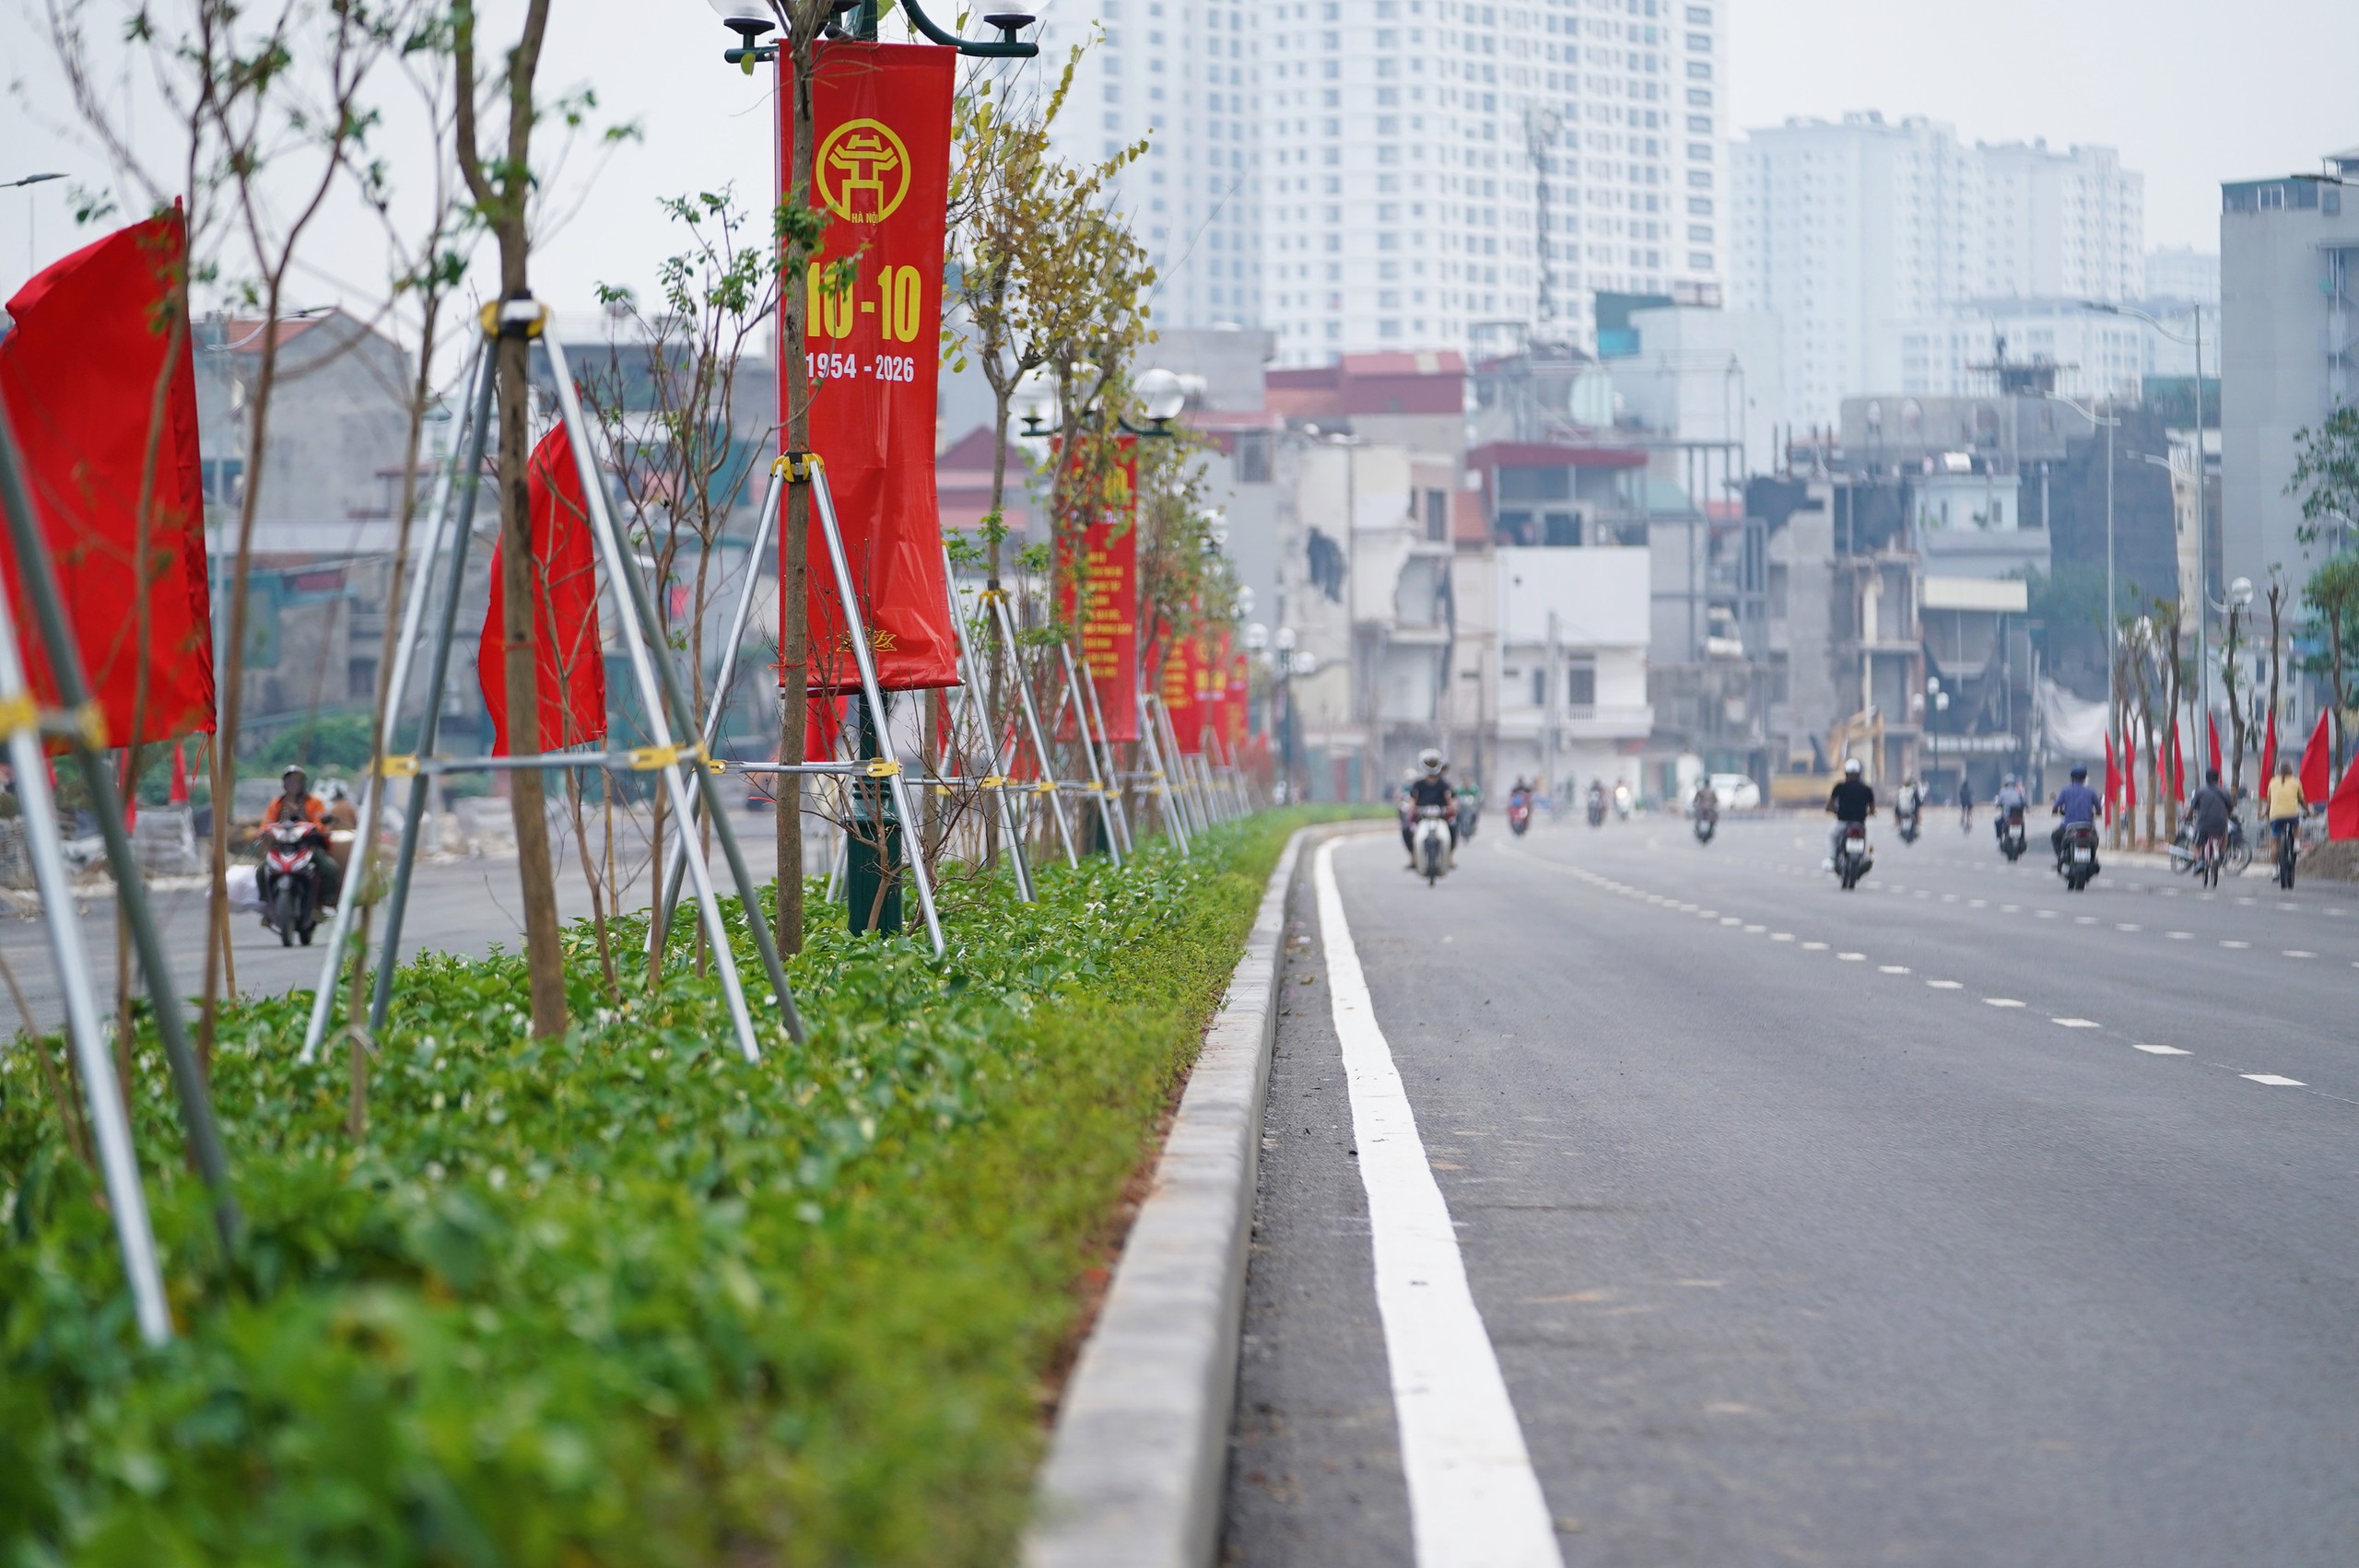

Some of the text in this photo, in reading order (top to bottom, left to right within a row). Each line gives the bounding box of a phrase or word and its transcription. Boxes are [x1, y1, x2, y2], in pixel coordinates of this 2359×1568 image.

[851, 211, 863, 224] HÀ
[805, 353, 857, 379] 1954
[875, 355, 914, 382] 2026
